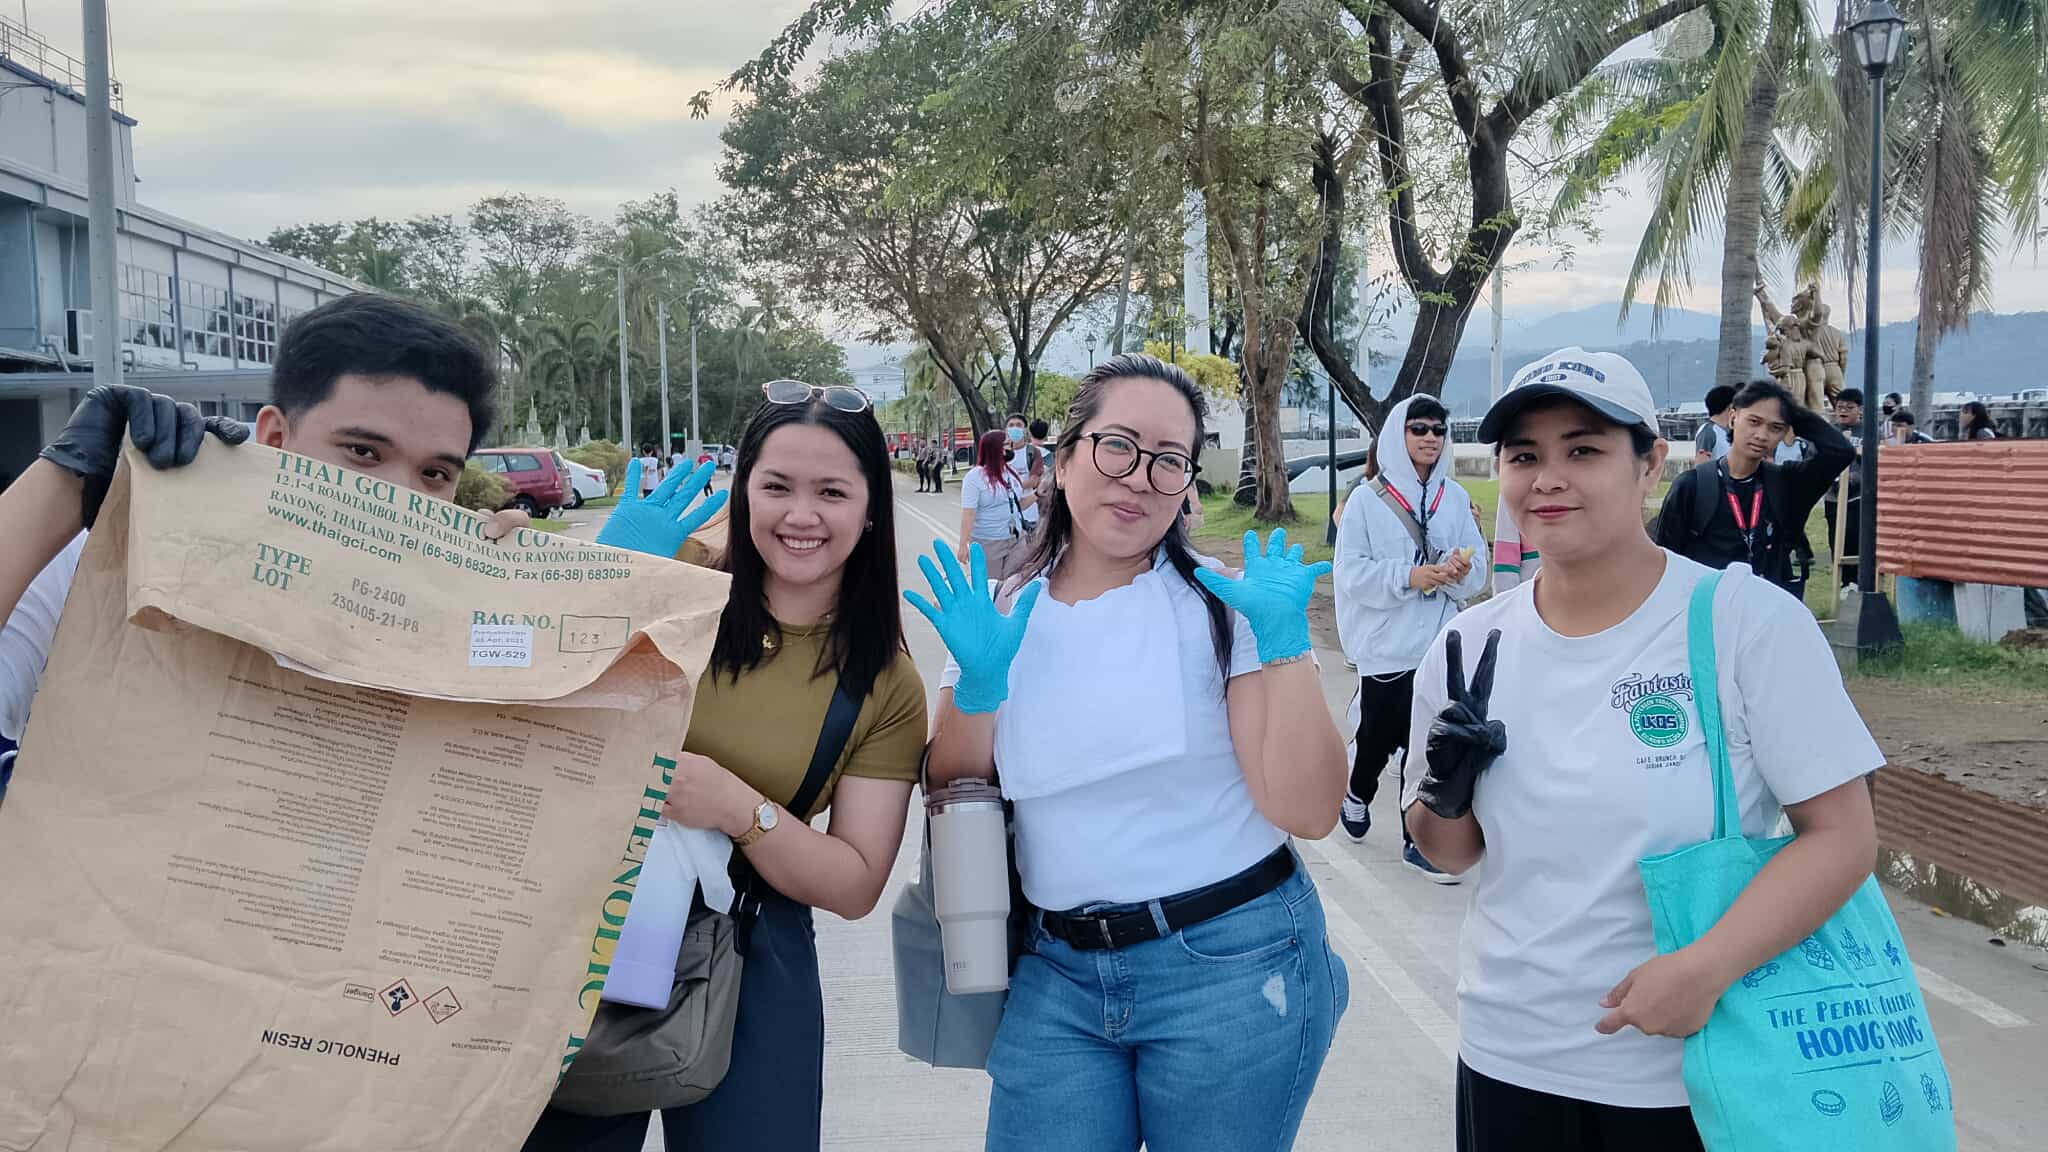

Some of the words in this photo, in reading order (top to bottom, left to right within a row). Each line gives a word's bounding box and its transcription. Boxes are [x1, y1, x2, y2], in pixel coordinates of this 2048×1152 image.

[276, 451, 346, 488] THAI
[354, 475, 398, 505] GCI
[407, 491, 502, 546] RESITO
[266, 504, 403, 564] www.thaigci.com
[256, 542, 314, 577] TYPE
[399, 532, 420, 551] Tel
[422, 541, 464, 569] (66-38)
[464, 557, 511, 581] 683223,
[514, 569, 540, 581] Fax
[540, 568, 584, 584] (66-38)
[586, 568, 632, 581] 683099
[525, 550, 575, 564] RAYONG
[251, 562, 294, 591] LOT
[350, 577, 407, 608] PG-2400
[471, 609, 515, 627] BAG
[521, 613, 557, 631] NO.
[1767, 1007, 1807, 1029] THE
[260, 1028, 314, 1052] RESIN
[316, 1038, 401, 1067] PHENOLIC
[1796, 1020, 1885, 1061] HONG
